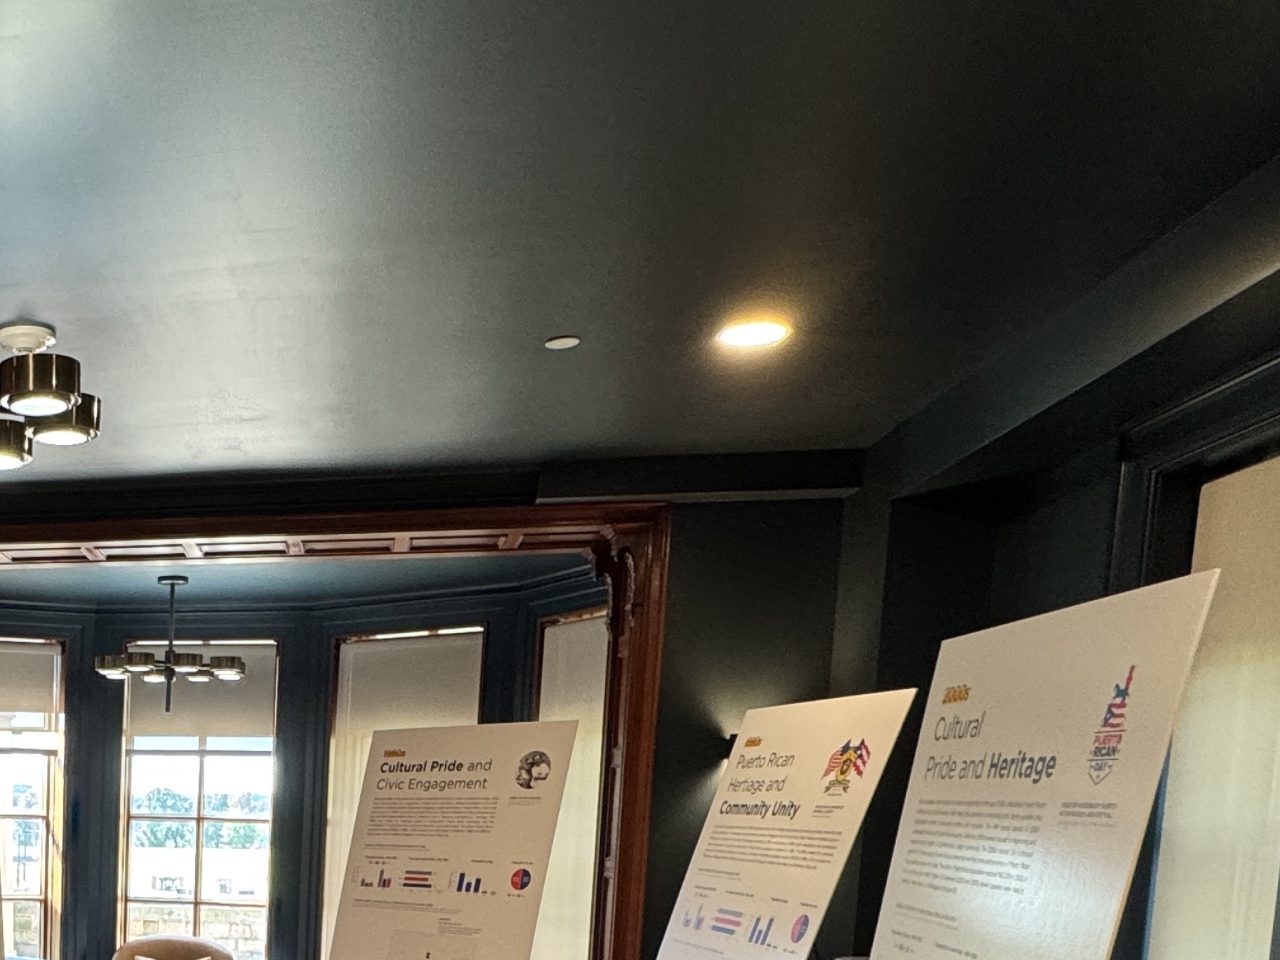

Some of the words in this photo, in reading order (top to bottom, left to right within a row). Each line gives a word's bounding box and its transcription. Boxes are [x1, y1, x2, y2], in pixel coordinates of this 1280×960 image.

[934, 710, 986, 741] Cultural
[380, 760, 427, 773] Cultural
[430, 760, 463, 773] Pride
[467, 759, 493, 772] and
[736, 754, 766, 769] Puerto
[767, 752, 795, 769] Rican
[924, 755, 957, 780] Pride
[958, 752, 987, 780] and
[987, 750, 1057, 785] Heritage
[376, 778, 405, 790] Civic
[407, 777, 488, 792] Engagement
[765, 776, 788, 792] and
[719, 800, 771, 819] Community
[771, 800, 801, 820] Unity
